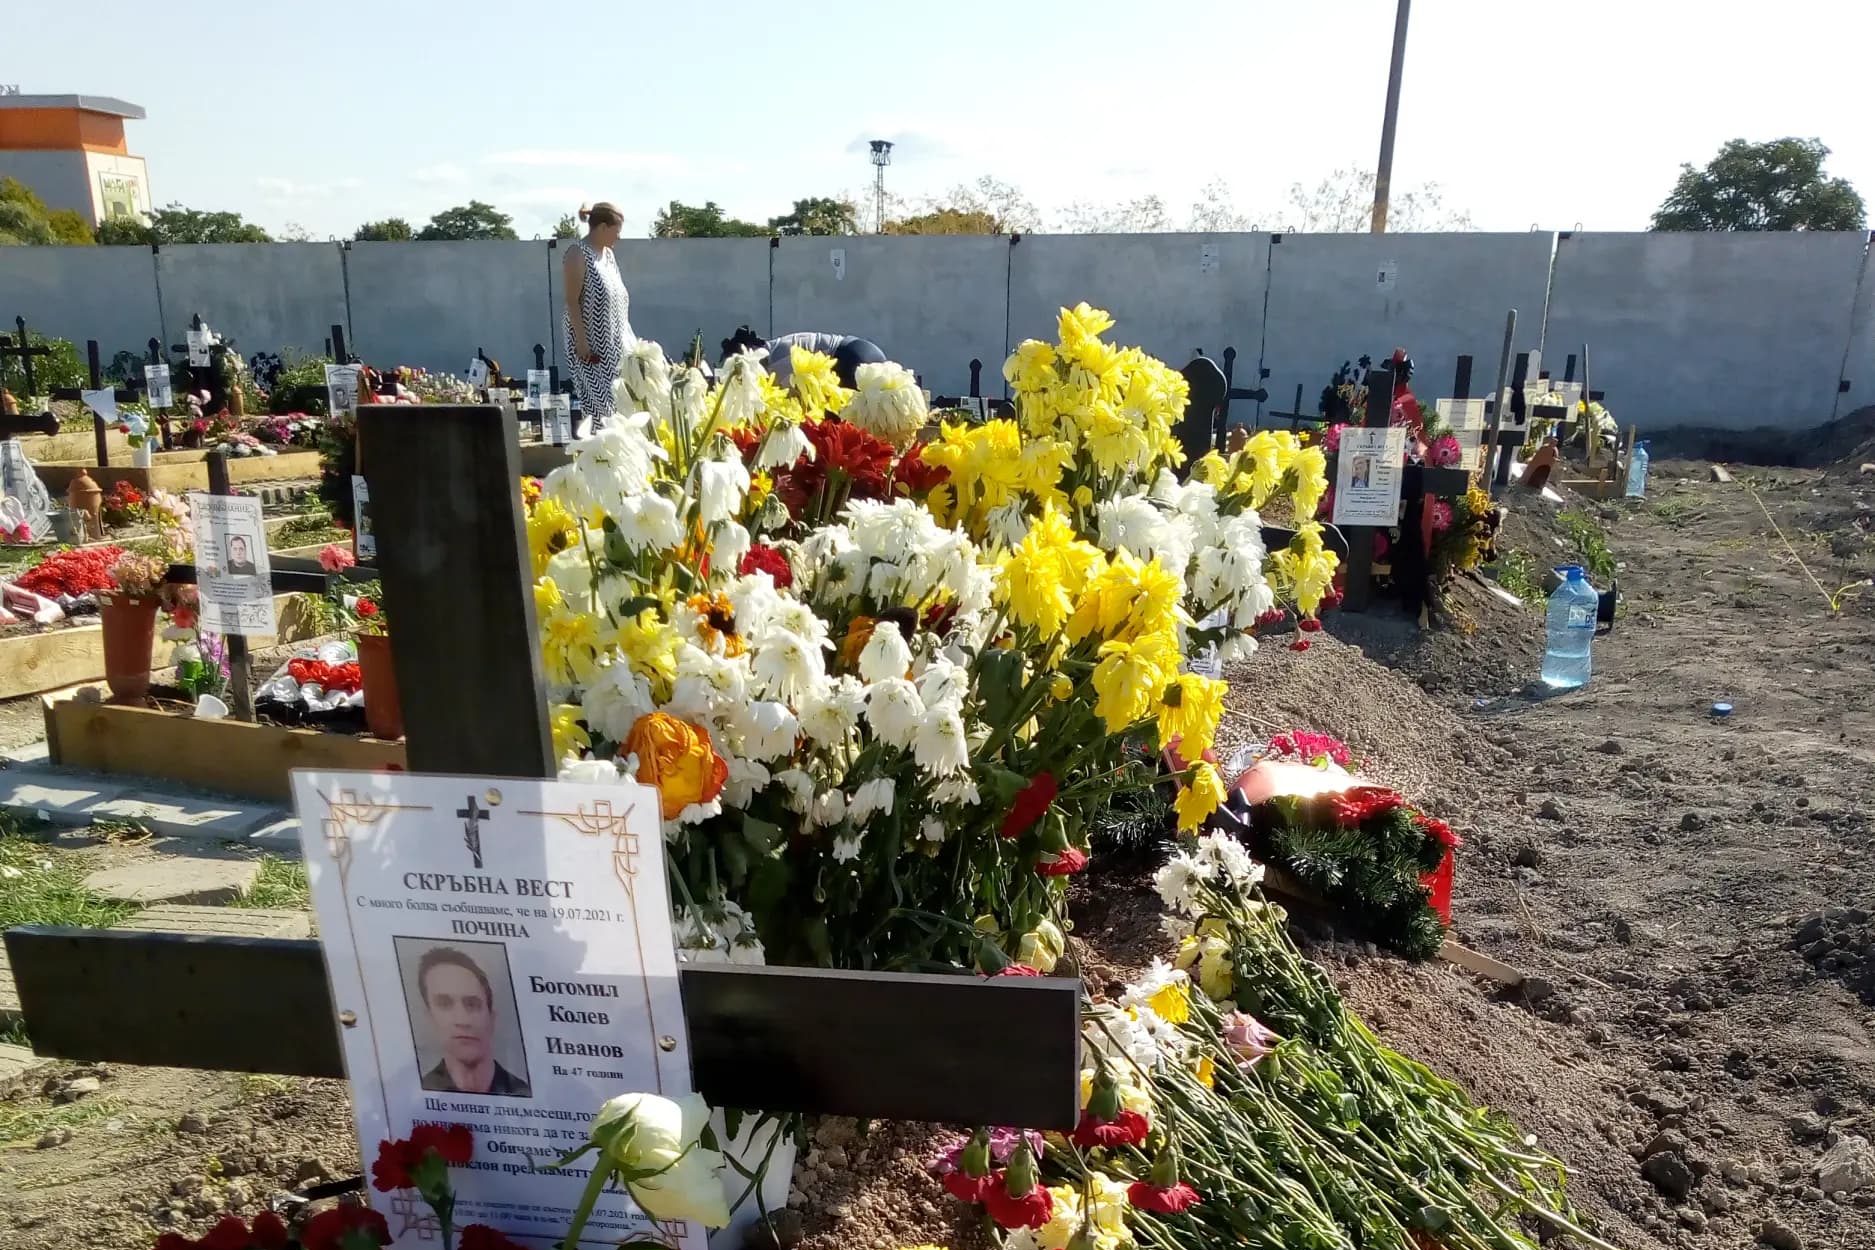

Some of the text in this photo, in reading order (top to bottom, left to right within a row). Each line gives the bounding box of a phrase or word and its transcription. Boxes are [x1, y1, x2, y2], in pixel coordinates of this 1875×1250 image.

[403, 872, 575, 899] СКРЪБНА ВЕСТ
[356, 897, 625, 923] С много болка съобщаваме, че на 19.07.2021 г.
[451, 919, 530, 939] ПОЧИНА
[528, 975, 620, 998] Богомил
[547, 1004, 610, 1025] Колев
[545, 1036, 624, 1058] Иванов
[552, 1065, 624, 1080] На 47 години
[425, 1097, 448, 1112] Ще
[451, 1103, 490, 1115] минат
[493, 1123, 540, 1138] никога
[543, 1128, 558, 1139] да
[562, 1129, 575, 1140] те
[487, 1140, 553, 1157] Обичаме
[502, 1162, 536, 1176] пред
